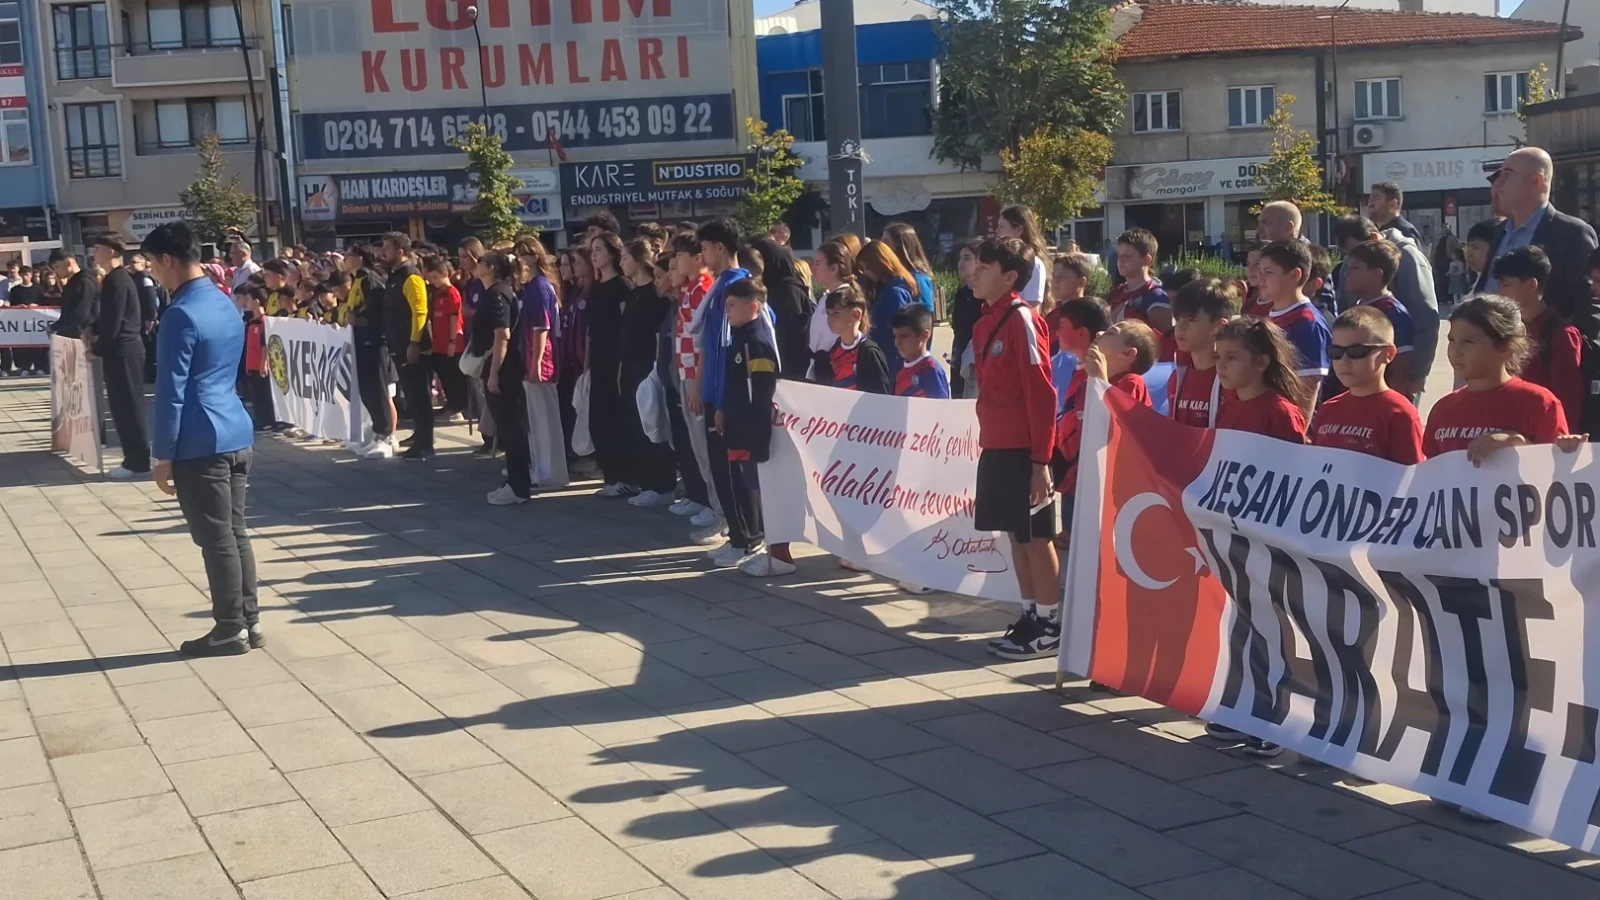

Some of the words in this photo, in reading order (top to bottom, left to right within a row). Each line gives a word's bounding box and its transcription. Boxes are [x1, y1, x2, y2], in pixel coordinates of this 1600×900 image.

[361, 36, 690, 93] KURUMLARI
[324, 118, 384, 151] 0284
[389, 116, 435, 149] 714
[531, 109, 591, 142] 0544
[597, 106, 640, 138] 453
[647, 104, 676, 135] 09
[683, 102, 713, 133] 22
[340, 178, 370, 200] HAN
[371, 175, 448, 198] KARDEŞLER
[574, 163, 635, 188] KARE
[648, 188, 693, 202] MUTFAK
[695, 187, 703, 199] &
[1155, 185, 1196, 196] mangal
[132, 211, 176, 221] SERİNLER
[371, 204, 384, 213] Ve
[384, 202, 415, 212] Yemek
[800, 415, 907, 450] sporcunun
[944, 425, 974, 465] çevik
[1340, 425, 1374, 439] KARATE
[1198, 459, 1303, 531] KEŞAN
[1300, 462, 1419, 546] ÖNDER
[1413, 486, 1483, 550] CAN
[1494, 480, 1597, 549] SPOR
